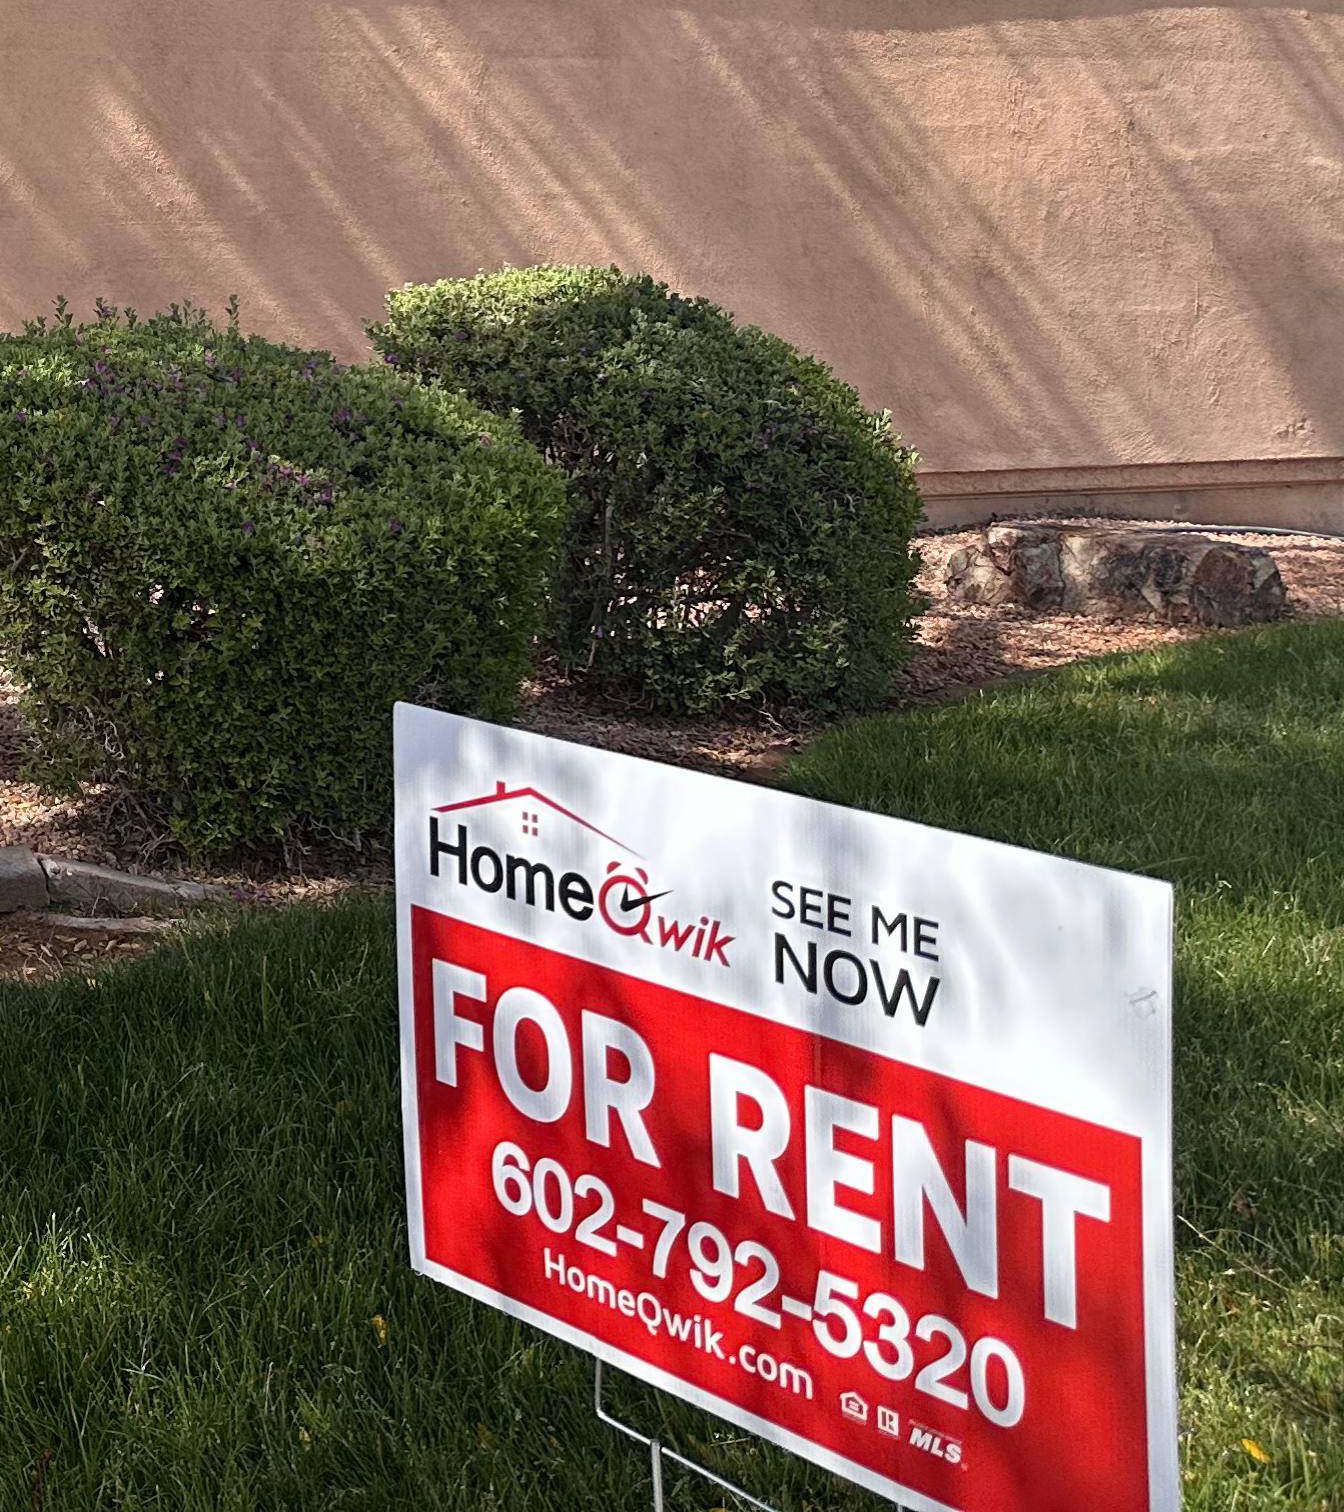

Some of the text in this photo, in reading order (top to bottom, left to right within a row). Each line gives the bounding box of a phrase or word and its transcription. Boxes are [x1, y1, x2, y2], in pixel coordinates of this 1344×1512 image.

[771, 880, 939, 962] SEE ME
[775, 932, 941, 1028] NOW
[432, 958, 1111, 1330] FOR RENT
[492, 1141, 1026, 1429] 602-792-5320
[543, 1248, 813, 1400] HomeQwik.com
[909, 1427, 962, 1464] MLS
